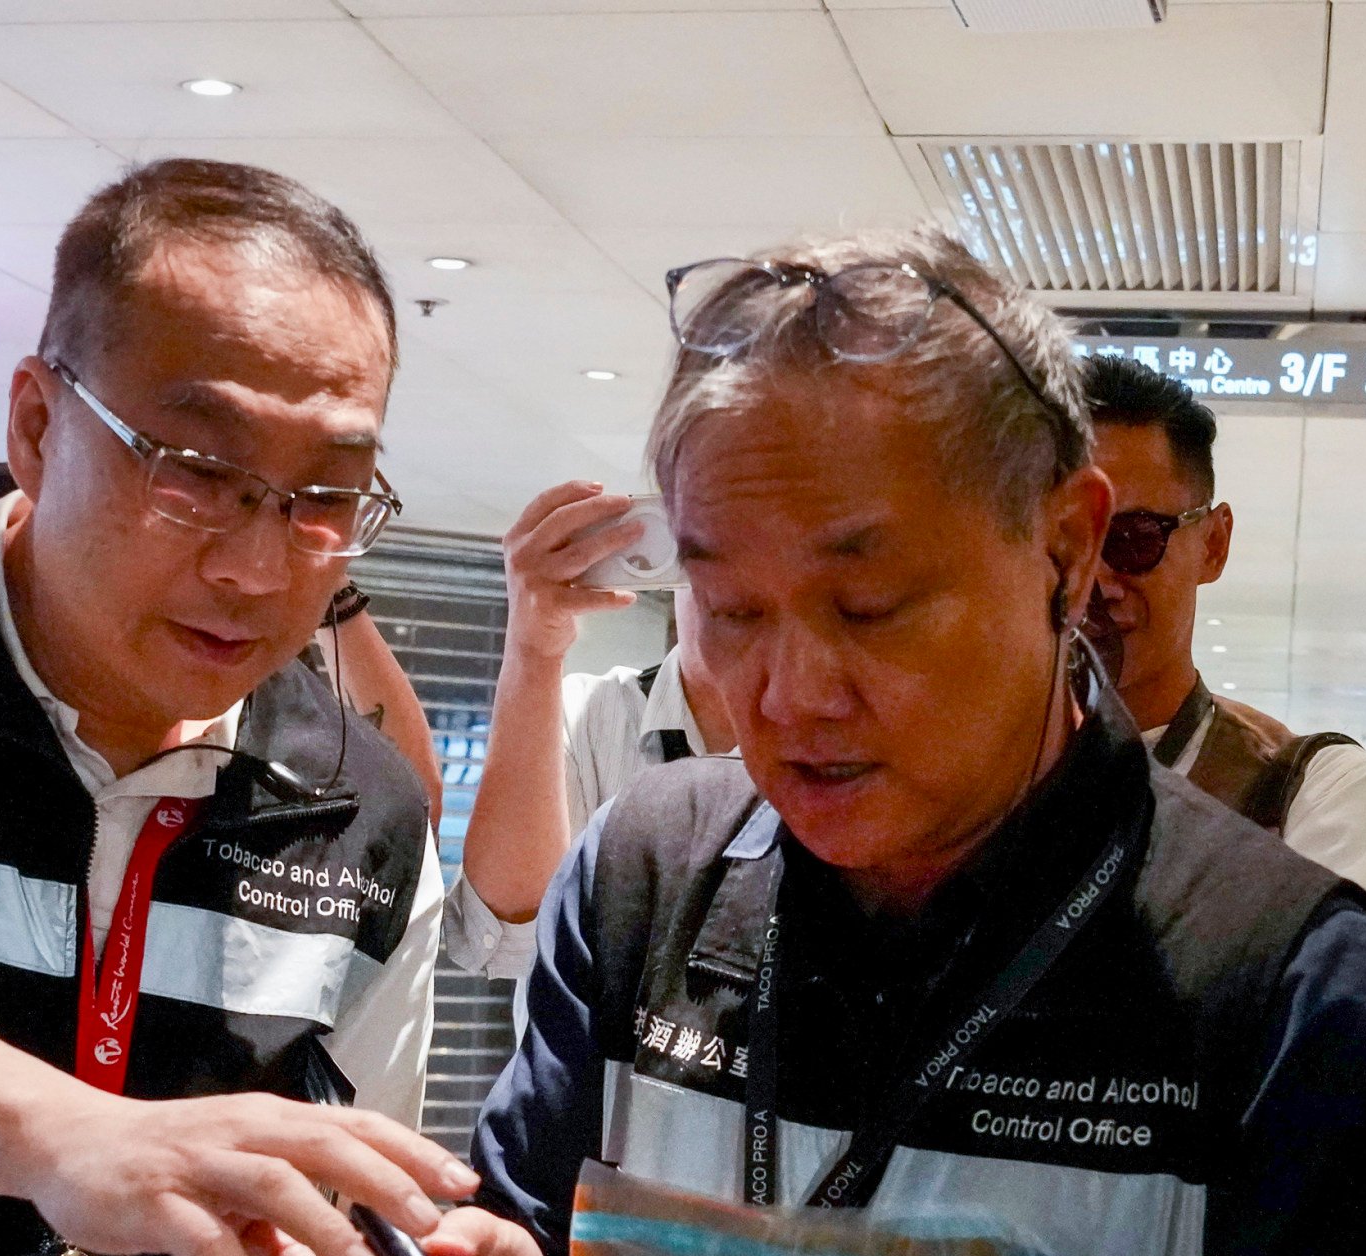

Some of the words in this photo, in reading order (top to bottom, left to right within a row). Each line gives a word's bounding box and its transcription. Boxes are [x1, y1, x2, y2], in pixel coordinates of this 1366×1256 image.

[1211, 374, 1271, 395] Centre
[1280, 352, 1348, 397] 3/F
[203, 838, 285, 878] Tobacco
[290, 865, 330, 888] and
[238, 880, 310, 919] Control
[1067, 882, 1099, 918] PRO
[1055, 914, 1071, 929] A
[762, 928, 780, 964] PRO
[757, 966, 772, 1013] TACO
[955, 1004, 998, 1044] TACO
[926, 1041, 960, 1077] PRO
[915, 1071, 929, 1087] A
[1045, 1076, 1096, 1101] and
[1101, 1076, 1200, 1111] Alcohol
[753, 1110, 768, 1122] A
[971, 1109, 1063, 1142] Control
[1068, 1117, 1152, 1147] Office
[752, 1125, 768, 1162] PRO
[752, 1167, 767, 1206] ACO
[827, 1160, 864, 1200] TACO
